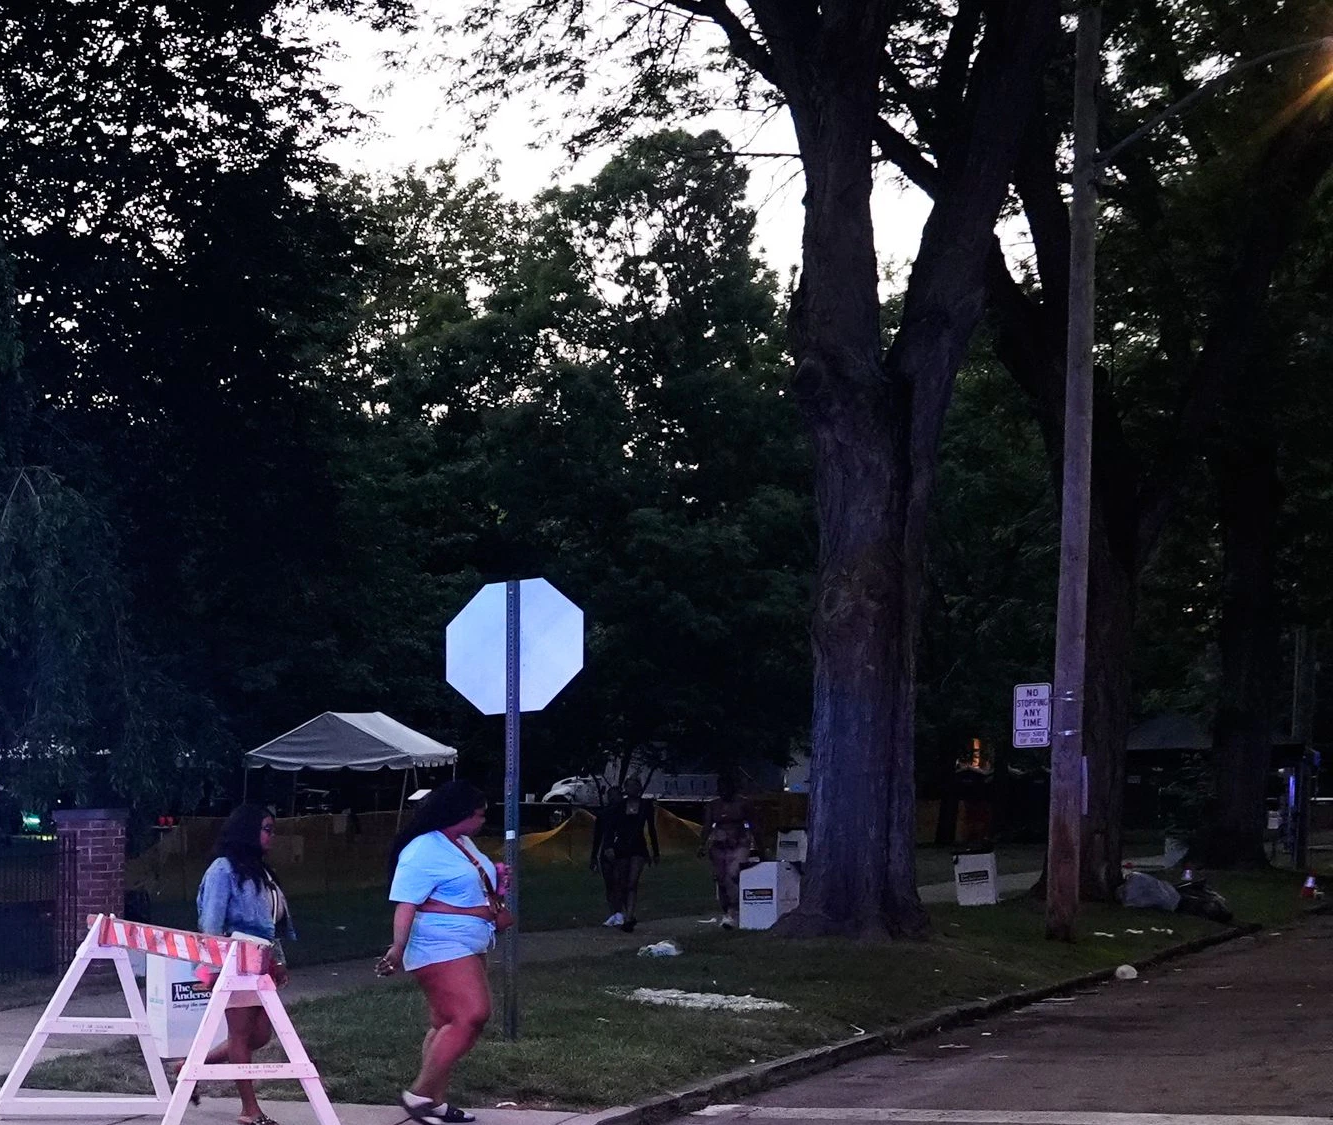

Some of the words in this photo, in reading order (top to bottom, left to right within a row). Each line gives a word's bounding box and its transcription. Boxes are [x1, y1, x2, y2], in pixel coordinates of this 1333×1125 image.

[1027, 689, 1039, 697] NO
[1017, 699, 1048, 708] STOPPING
[1024, 709, 1041, 717] ANY
[1022, 718, 1042, 727] TIME
[173, 984, 191, 993] The
[173, 990, 212, 1001] Anderso
